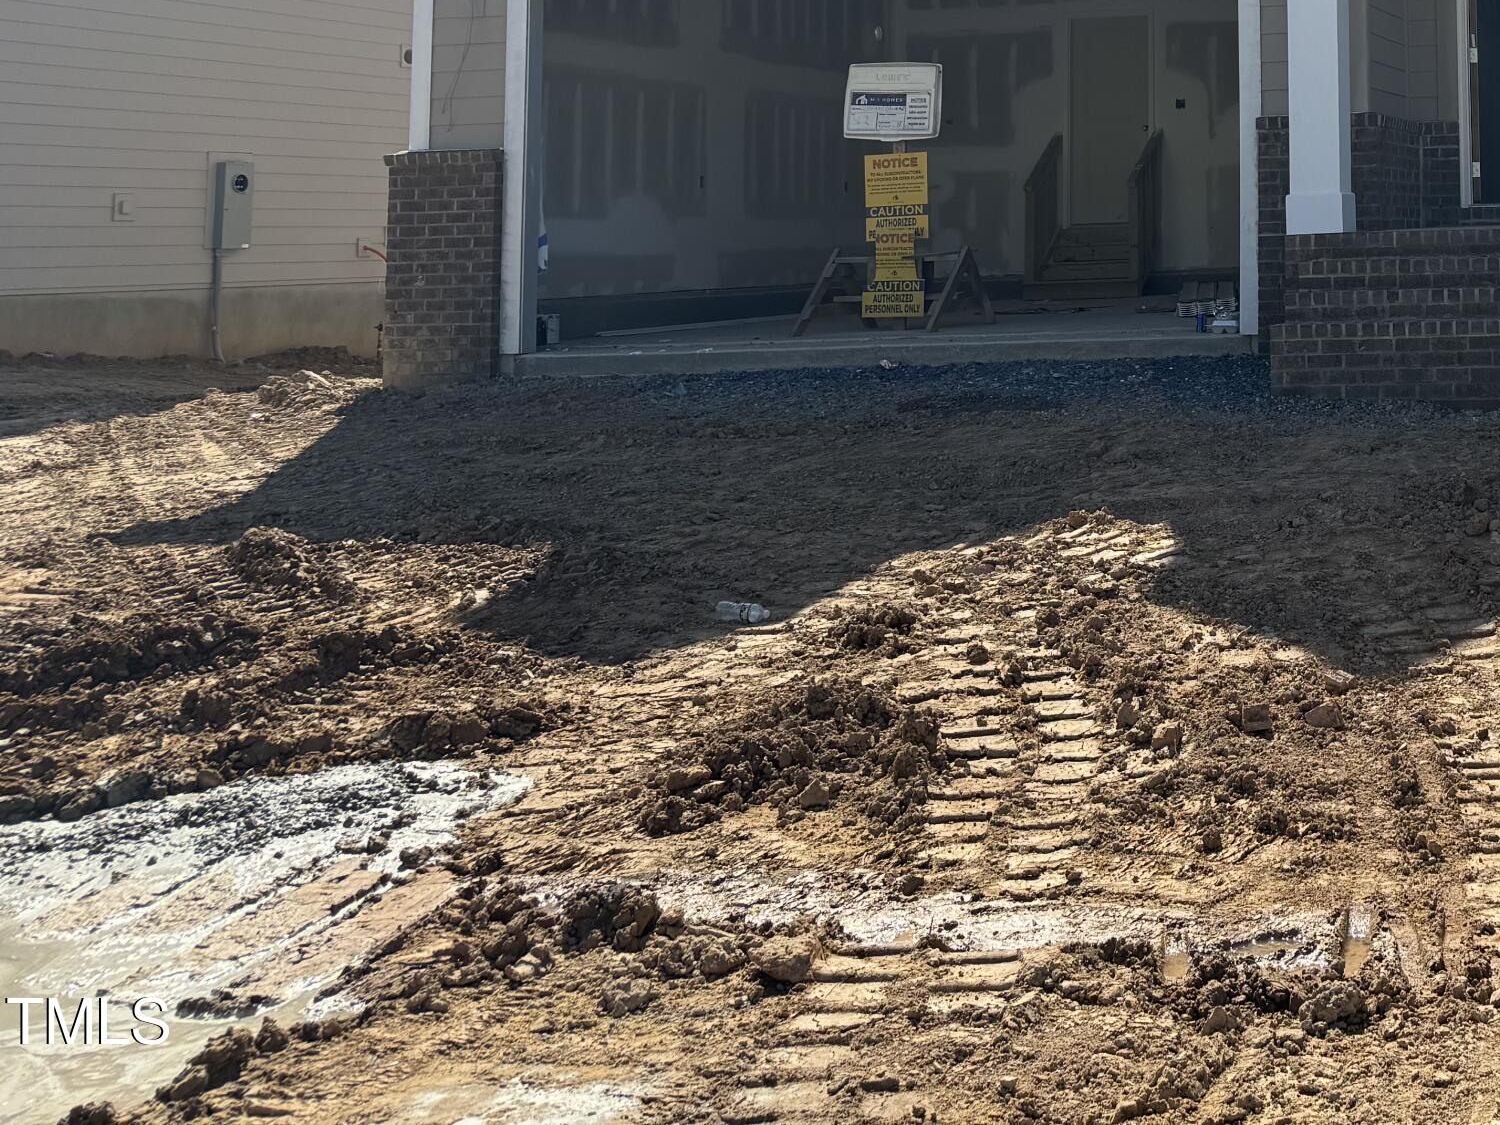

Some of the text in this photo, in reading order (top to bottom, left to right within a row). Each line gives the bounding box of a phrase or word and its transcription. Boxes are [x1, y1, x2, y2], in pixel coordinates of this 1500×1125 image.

[872, 157, 918, 170] NOTICE
[870, 205, 923, 217] CAUTION
[876, 217, 917, 228] AUTHORIZED
[867, 281, 920, 292] CAUTION
[873, 293, 914, 304] AUTHORIZED
[865, 303, 921, 314] PERSONNEL ONLY
